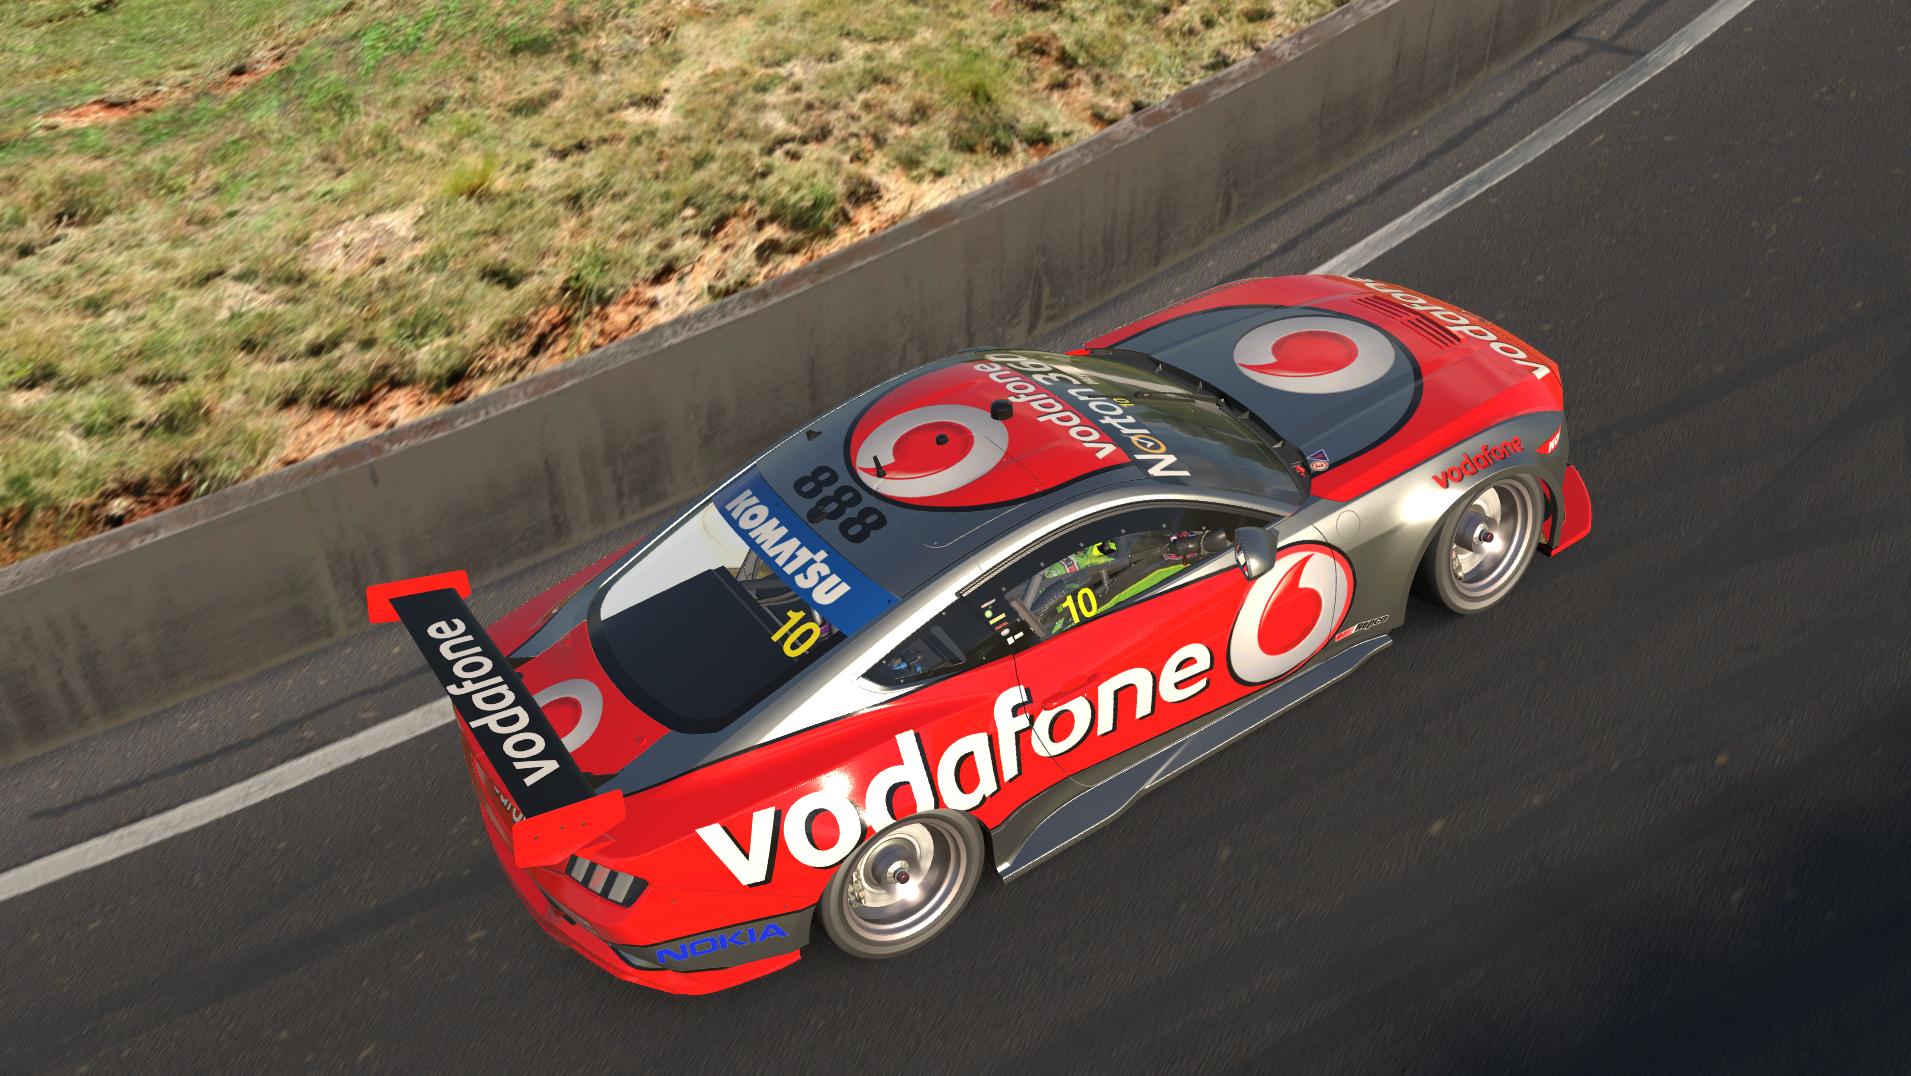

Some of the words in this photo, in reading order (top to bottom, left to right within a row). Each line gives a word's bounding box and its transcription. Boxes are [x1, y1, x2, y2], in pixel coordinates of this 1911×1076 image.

[984, 353, 1081, 386] 360
[973, 362, 1118, 460] vodafone
[1067, 388, 1192, 477] Norton
[1432, 435, 1525, 489] vodafone
[793, 465, 888, 544] 888
[724, 488, 852, 606] KOMATSU
[769, 607, 822, 658] 10
[1061, 587, 1099, 625] 10
[427, 617, 561, 788] vodafone
[695, 642, 1214, 887] vodafone
[656, 922, 788, 964] NOKIA
